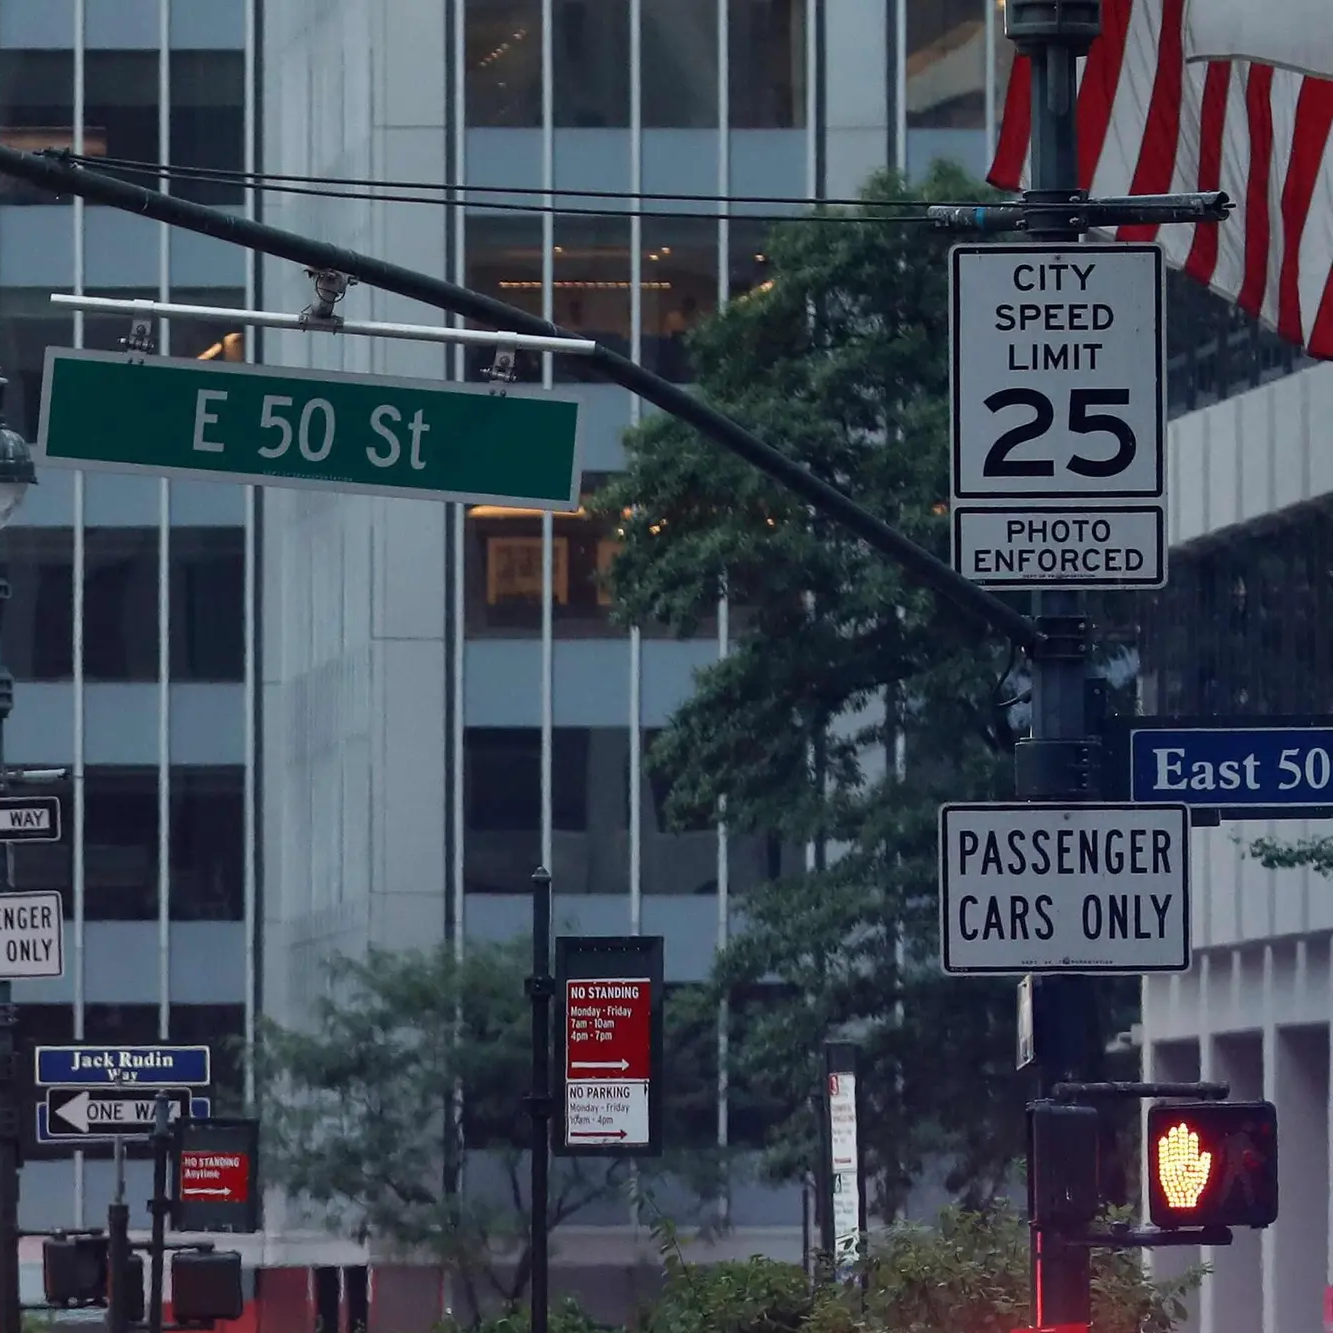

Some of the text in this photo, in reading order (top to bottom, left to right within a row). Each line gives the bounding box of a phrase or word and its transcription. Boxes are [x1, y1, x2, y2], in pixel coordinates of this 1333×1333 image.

[1014, 264, 1096, 291] CITY
[995, 304, 1114, 331] SPEED
[1008, 343, 1102, 371] LIMIT
[192, 389, 430, 470] E 50 St
[983, 388, 1137, 478] 25
[1007, 520, 1111, 543] PHOTO
[974, 549, 1143, 572] ENFORCED
[1152, 748, 1261, 790] East
[9, 810, 44, 828] WAY
[959, 829, 1172, 875] PASSENGER
[959, 894, 1172, 941] CARS ONLY
[6, 939, 53, 962] ONLY
[571, 986, 639, 999] NO STANDING
[571, 1005, 632, 1018] Monday Friday
[571, 1018, 615, 1029] 7am 10am
[571, 1031, 613, 1042] 4pm 7pm
[71, 1051, 174, 1070] Jack Rudin
[108, 1068, 138, 1082] Way
[570, 1086, 630, 1099] NO PARKING
[86, 1103, 124, 1121] ONE
[570, 1103, 630, 1114] Monday Friday
[597, 1115, 614, 1126] 4pm
[185, 1157, 240, 1167] NO STANDING
